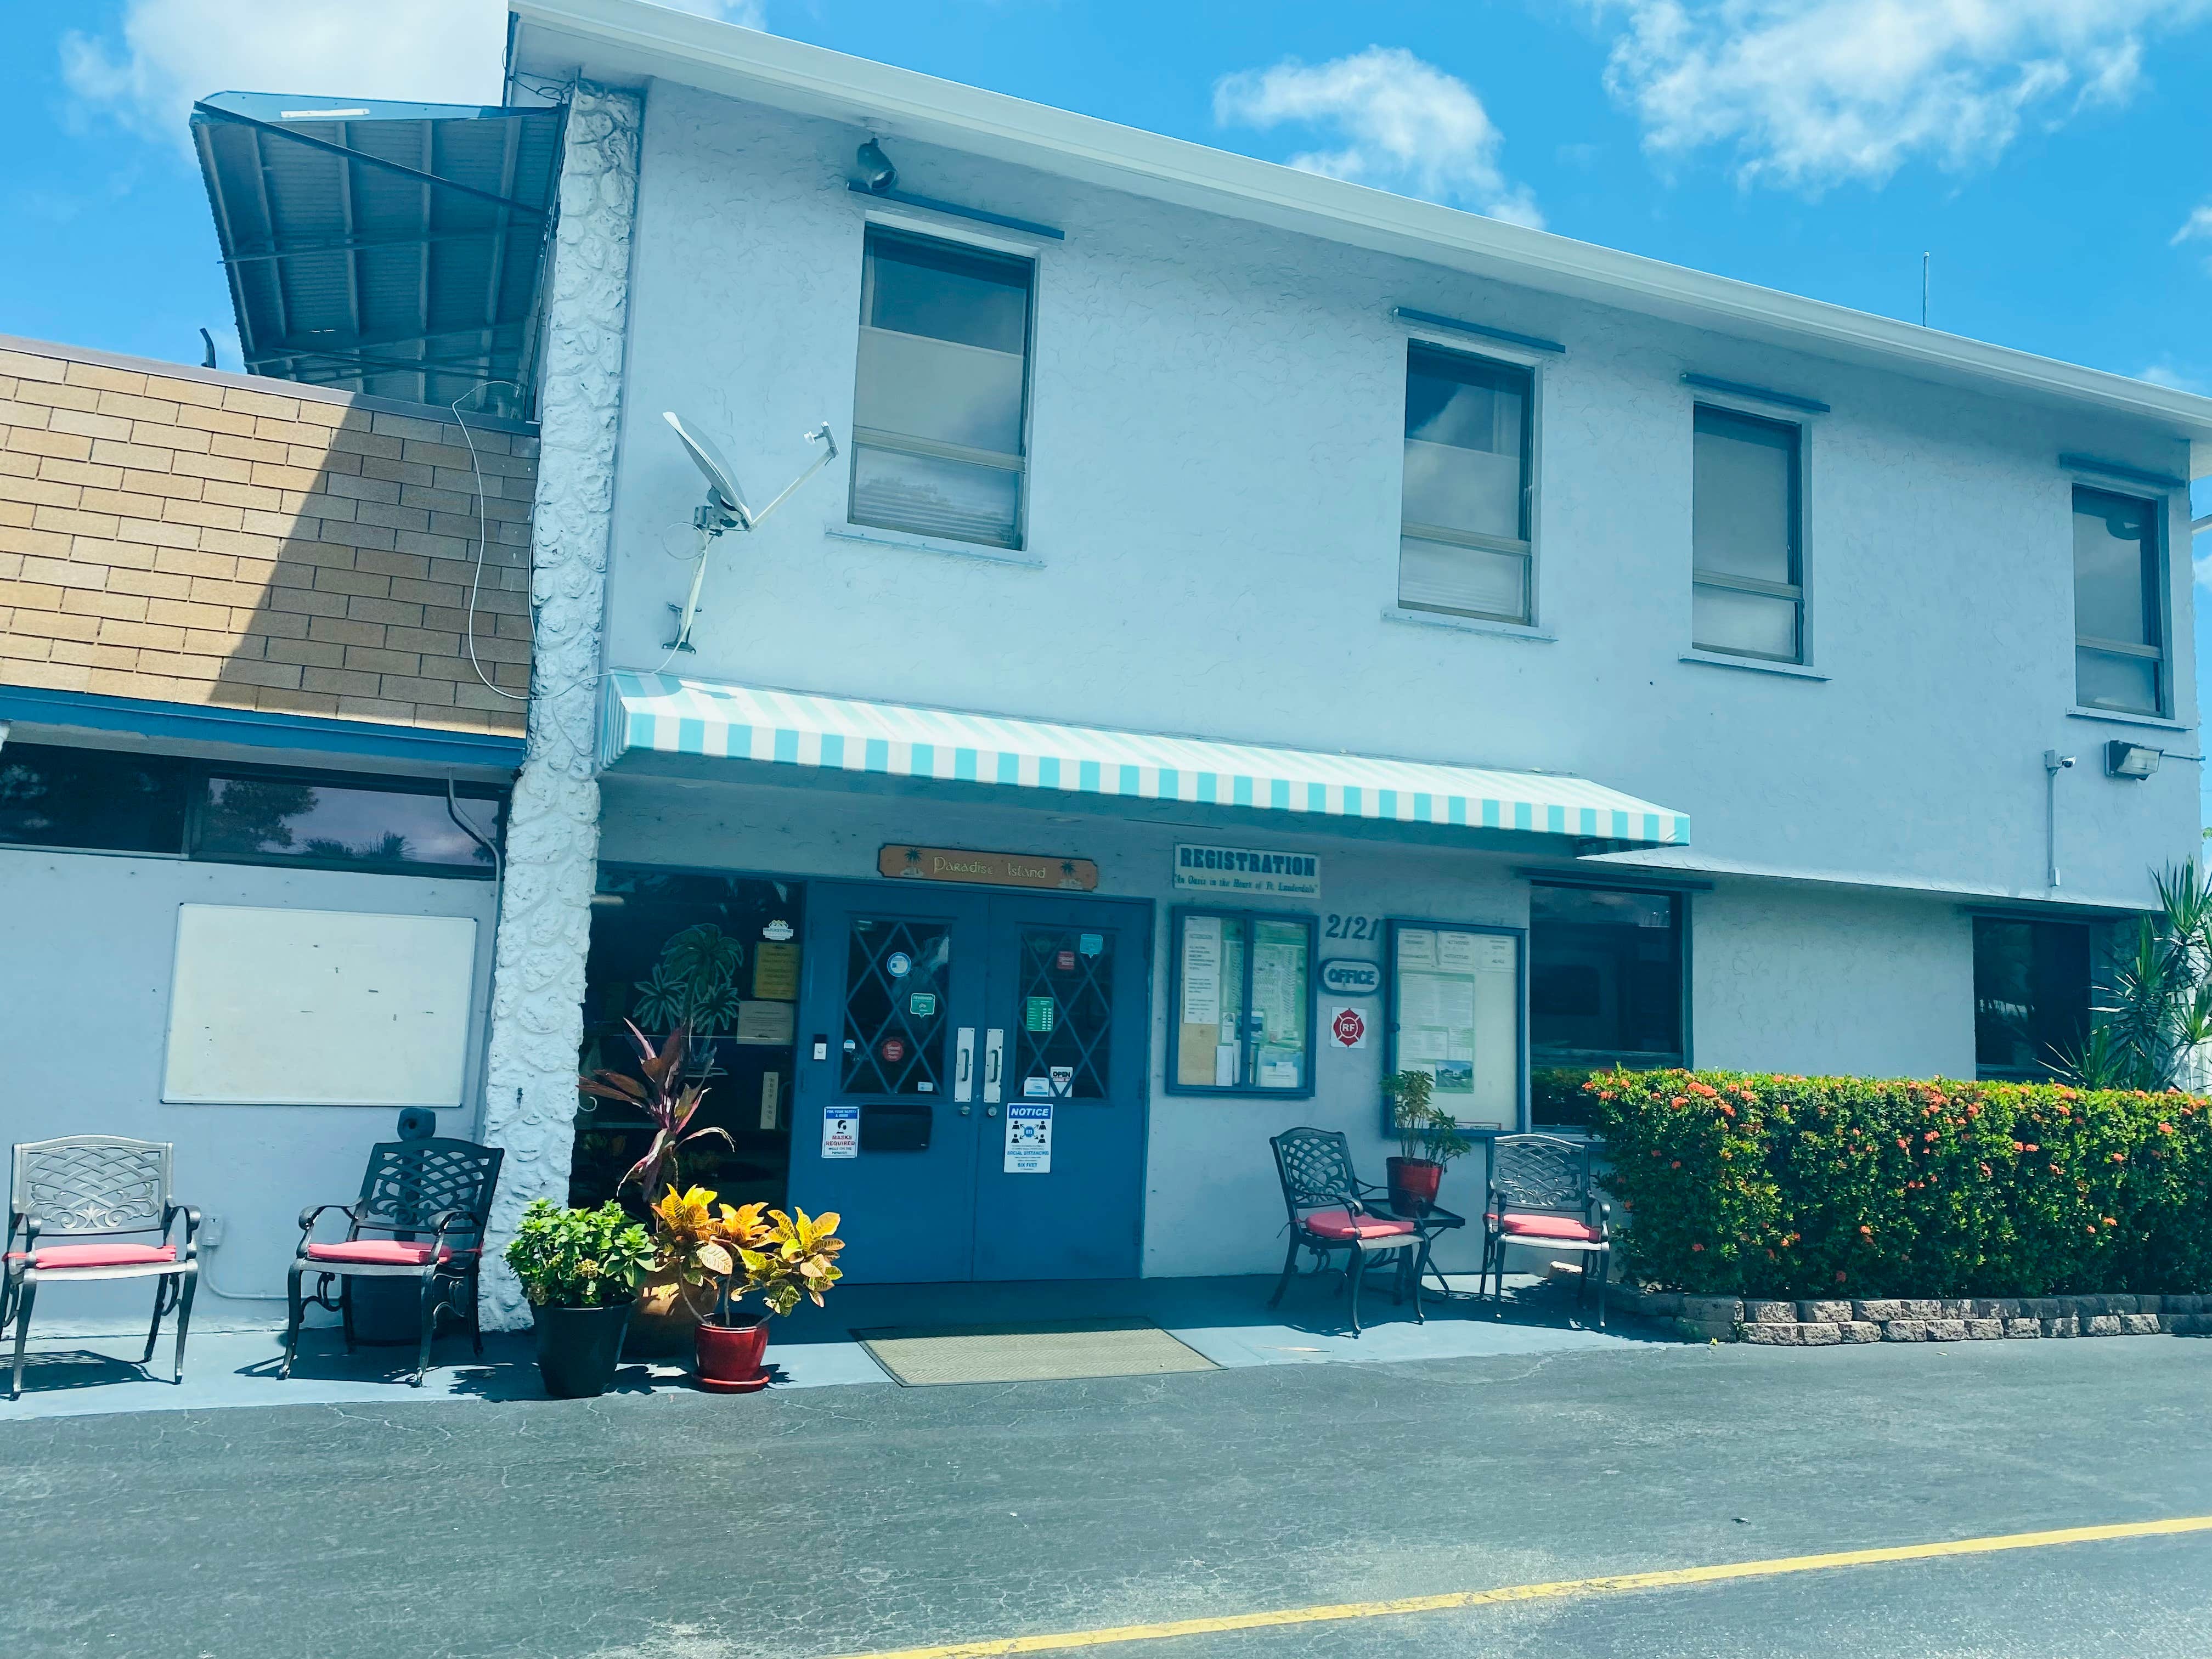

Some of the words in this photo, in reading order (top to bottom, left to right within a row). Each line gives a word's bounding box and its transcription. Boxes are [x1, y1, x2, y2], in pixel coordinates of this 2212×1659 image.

[933, 856, 993, 875] Paradise
[1007, 862, 1046, 879] Island
[1181, 848, 1315, 876] REGISTRATION
[1328, 968, 1375, 985] OFFICE
[1342, 1023, 1356, 1032] RF
[1011, 1108, 1049, 1116] NOTICE
